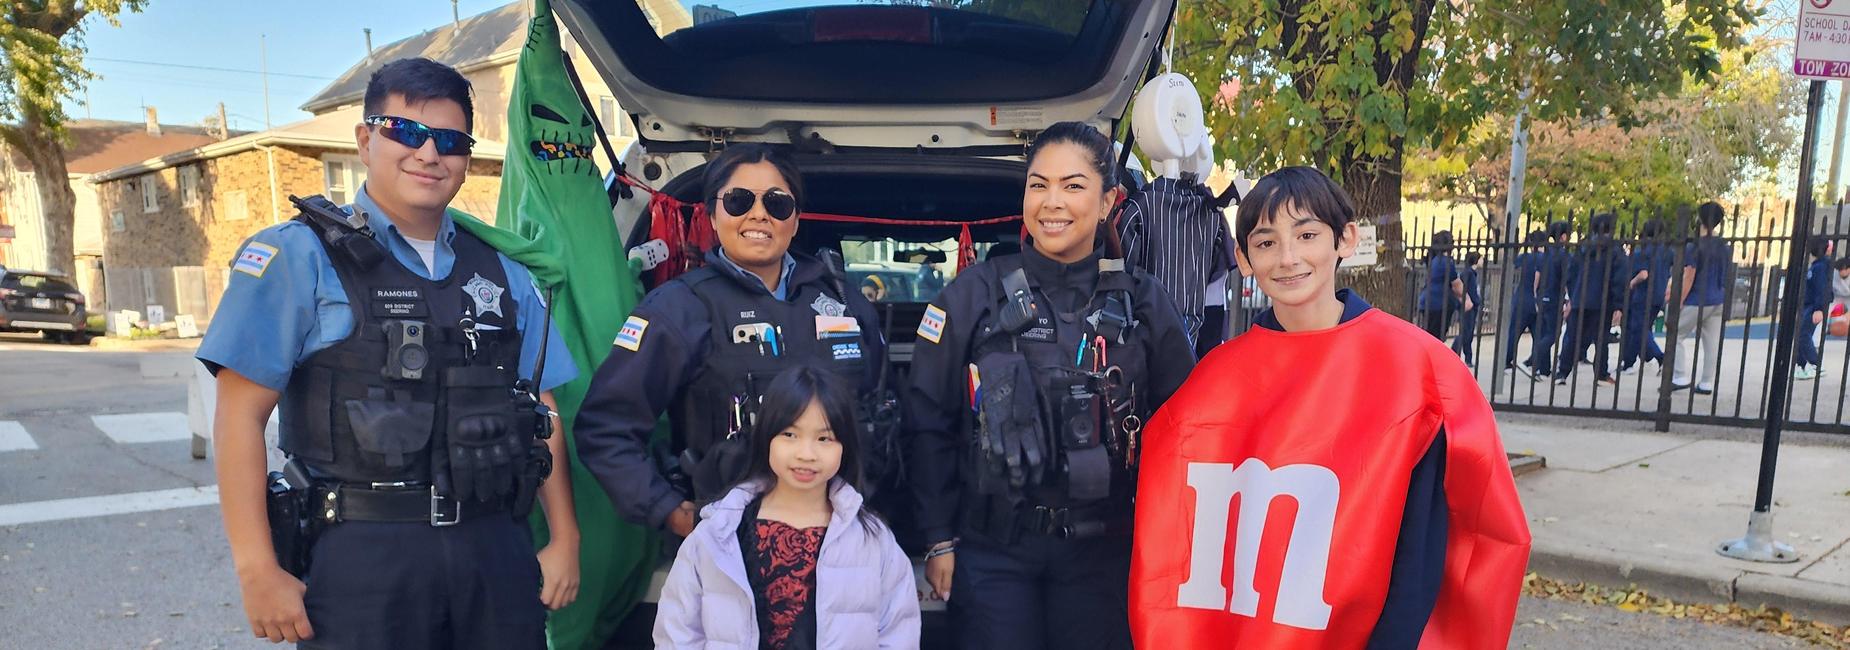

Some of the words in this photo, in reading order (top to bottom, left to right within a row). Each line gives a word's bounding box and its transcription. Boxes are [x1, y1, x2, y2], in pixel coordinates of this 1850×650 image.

[1804, 17, 1838, 30] SCHOOL
[1842, 20, 1850, 31] D
[1800, 60, 1826, 75] TOW
[377, 290, 418, 298] RAMONES
[740, 310, 756, 318] RUIZ
[1177, 457, 1341, 631] m
